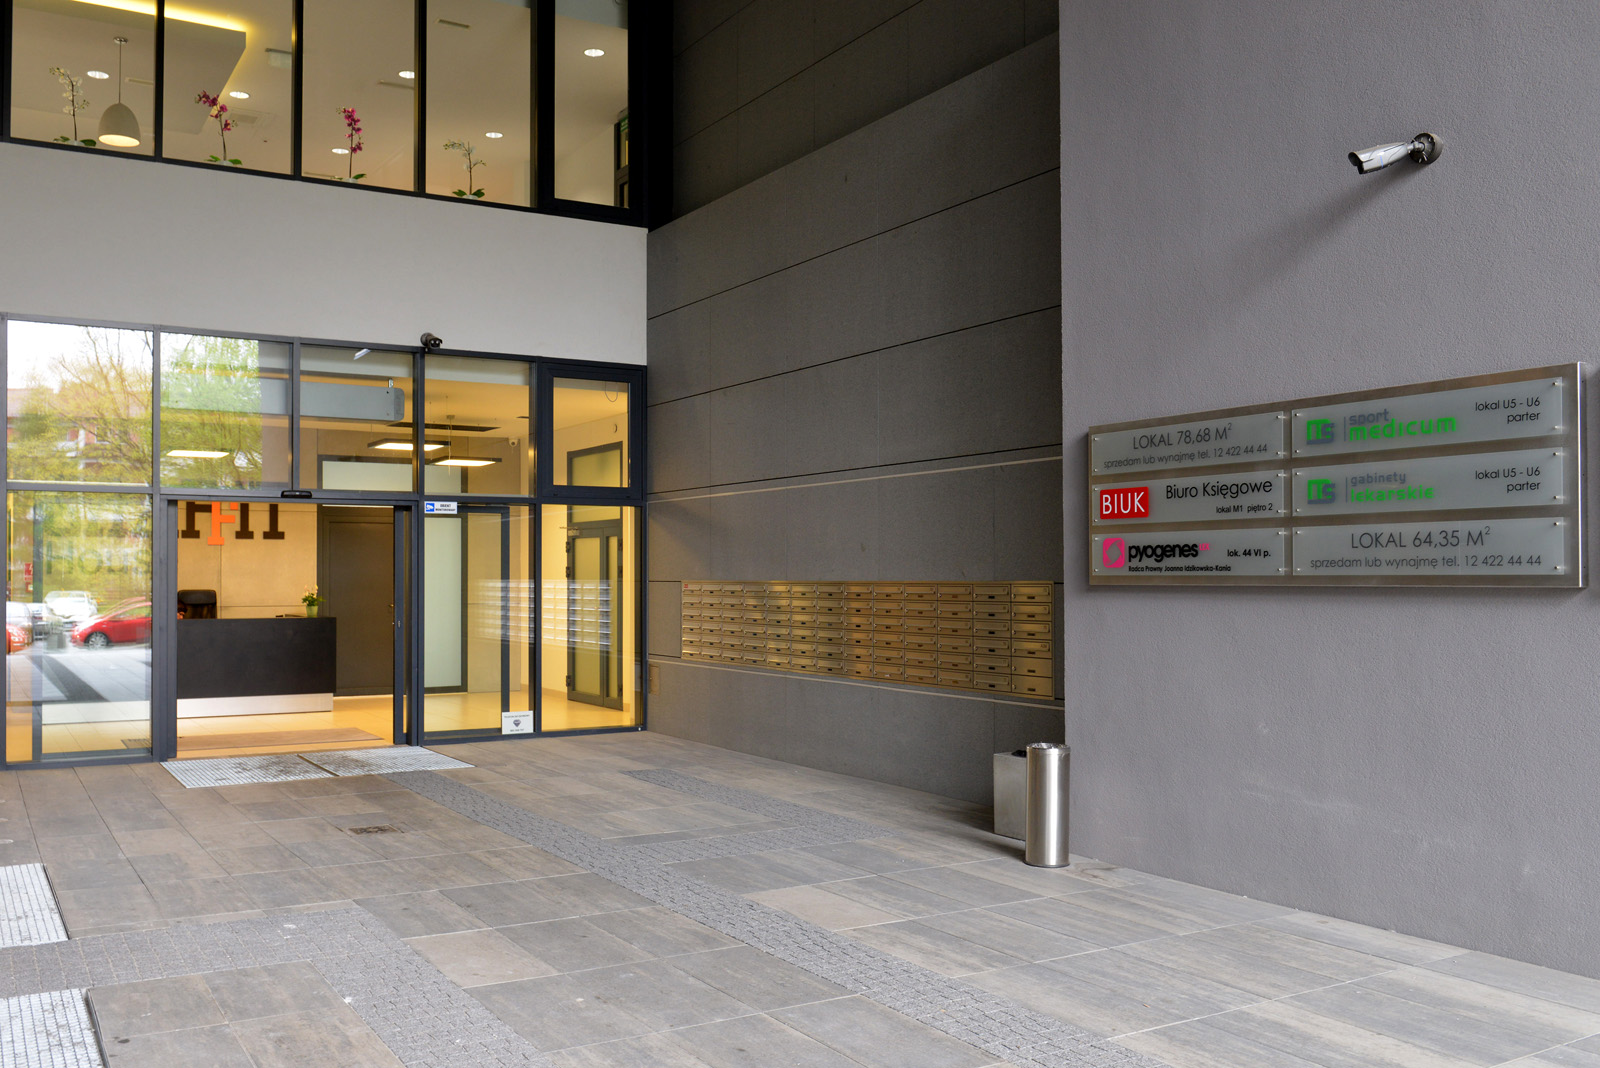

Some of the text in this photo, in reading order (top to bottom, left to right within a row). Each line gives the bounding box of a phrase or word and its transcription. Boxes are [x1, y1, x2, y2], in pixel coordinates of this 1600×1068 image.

[1475, 399, 1500, 411] lokal
[1503, 398, 1517, 409] U5
[1526, 397, 1540, 407] U6
[1349, 408, 1389, 426] sport
[1507, 411, 1540, 424] parter
[1349, 416, 1457, 442] medicum
[1133, 432, 1173, 450] LOKAL
[1177, 427, 1211, 446] 78,68
[1103, 443, 1268, 470] sprzedam lub wynajmę tel. 12 422 44 44
[1350, 472, 1406, 488] gabinety
[1475, 469, 1500, 480] lokal
[1503, 467, 1517, 478] U5
[1526, 466, 1540, 477] U6
[1166, 480, 1273, 500] Biuro Księgowe
[1351, 484, 1434, 503] lekarskie
[1506, 481, 1540, 494] parter
[1102, 491, 1146, 515] BIUK
[1216, 503, 1273, 514] lokal M1 piętro 2
[1351, 531, 1406, 549] LOKAL
[1413, 529, 1461, 549] 64,35
[1128, 543, 1199, 563] pyogenes
[1227, 548, 1271, 560] lok. 44 VI p.
[1310, 554, 1542, 570] sprzedam lub wynajmę tel. 12 422 44 44
